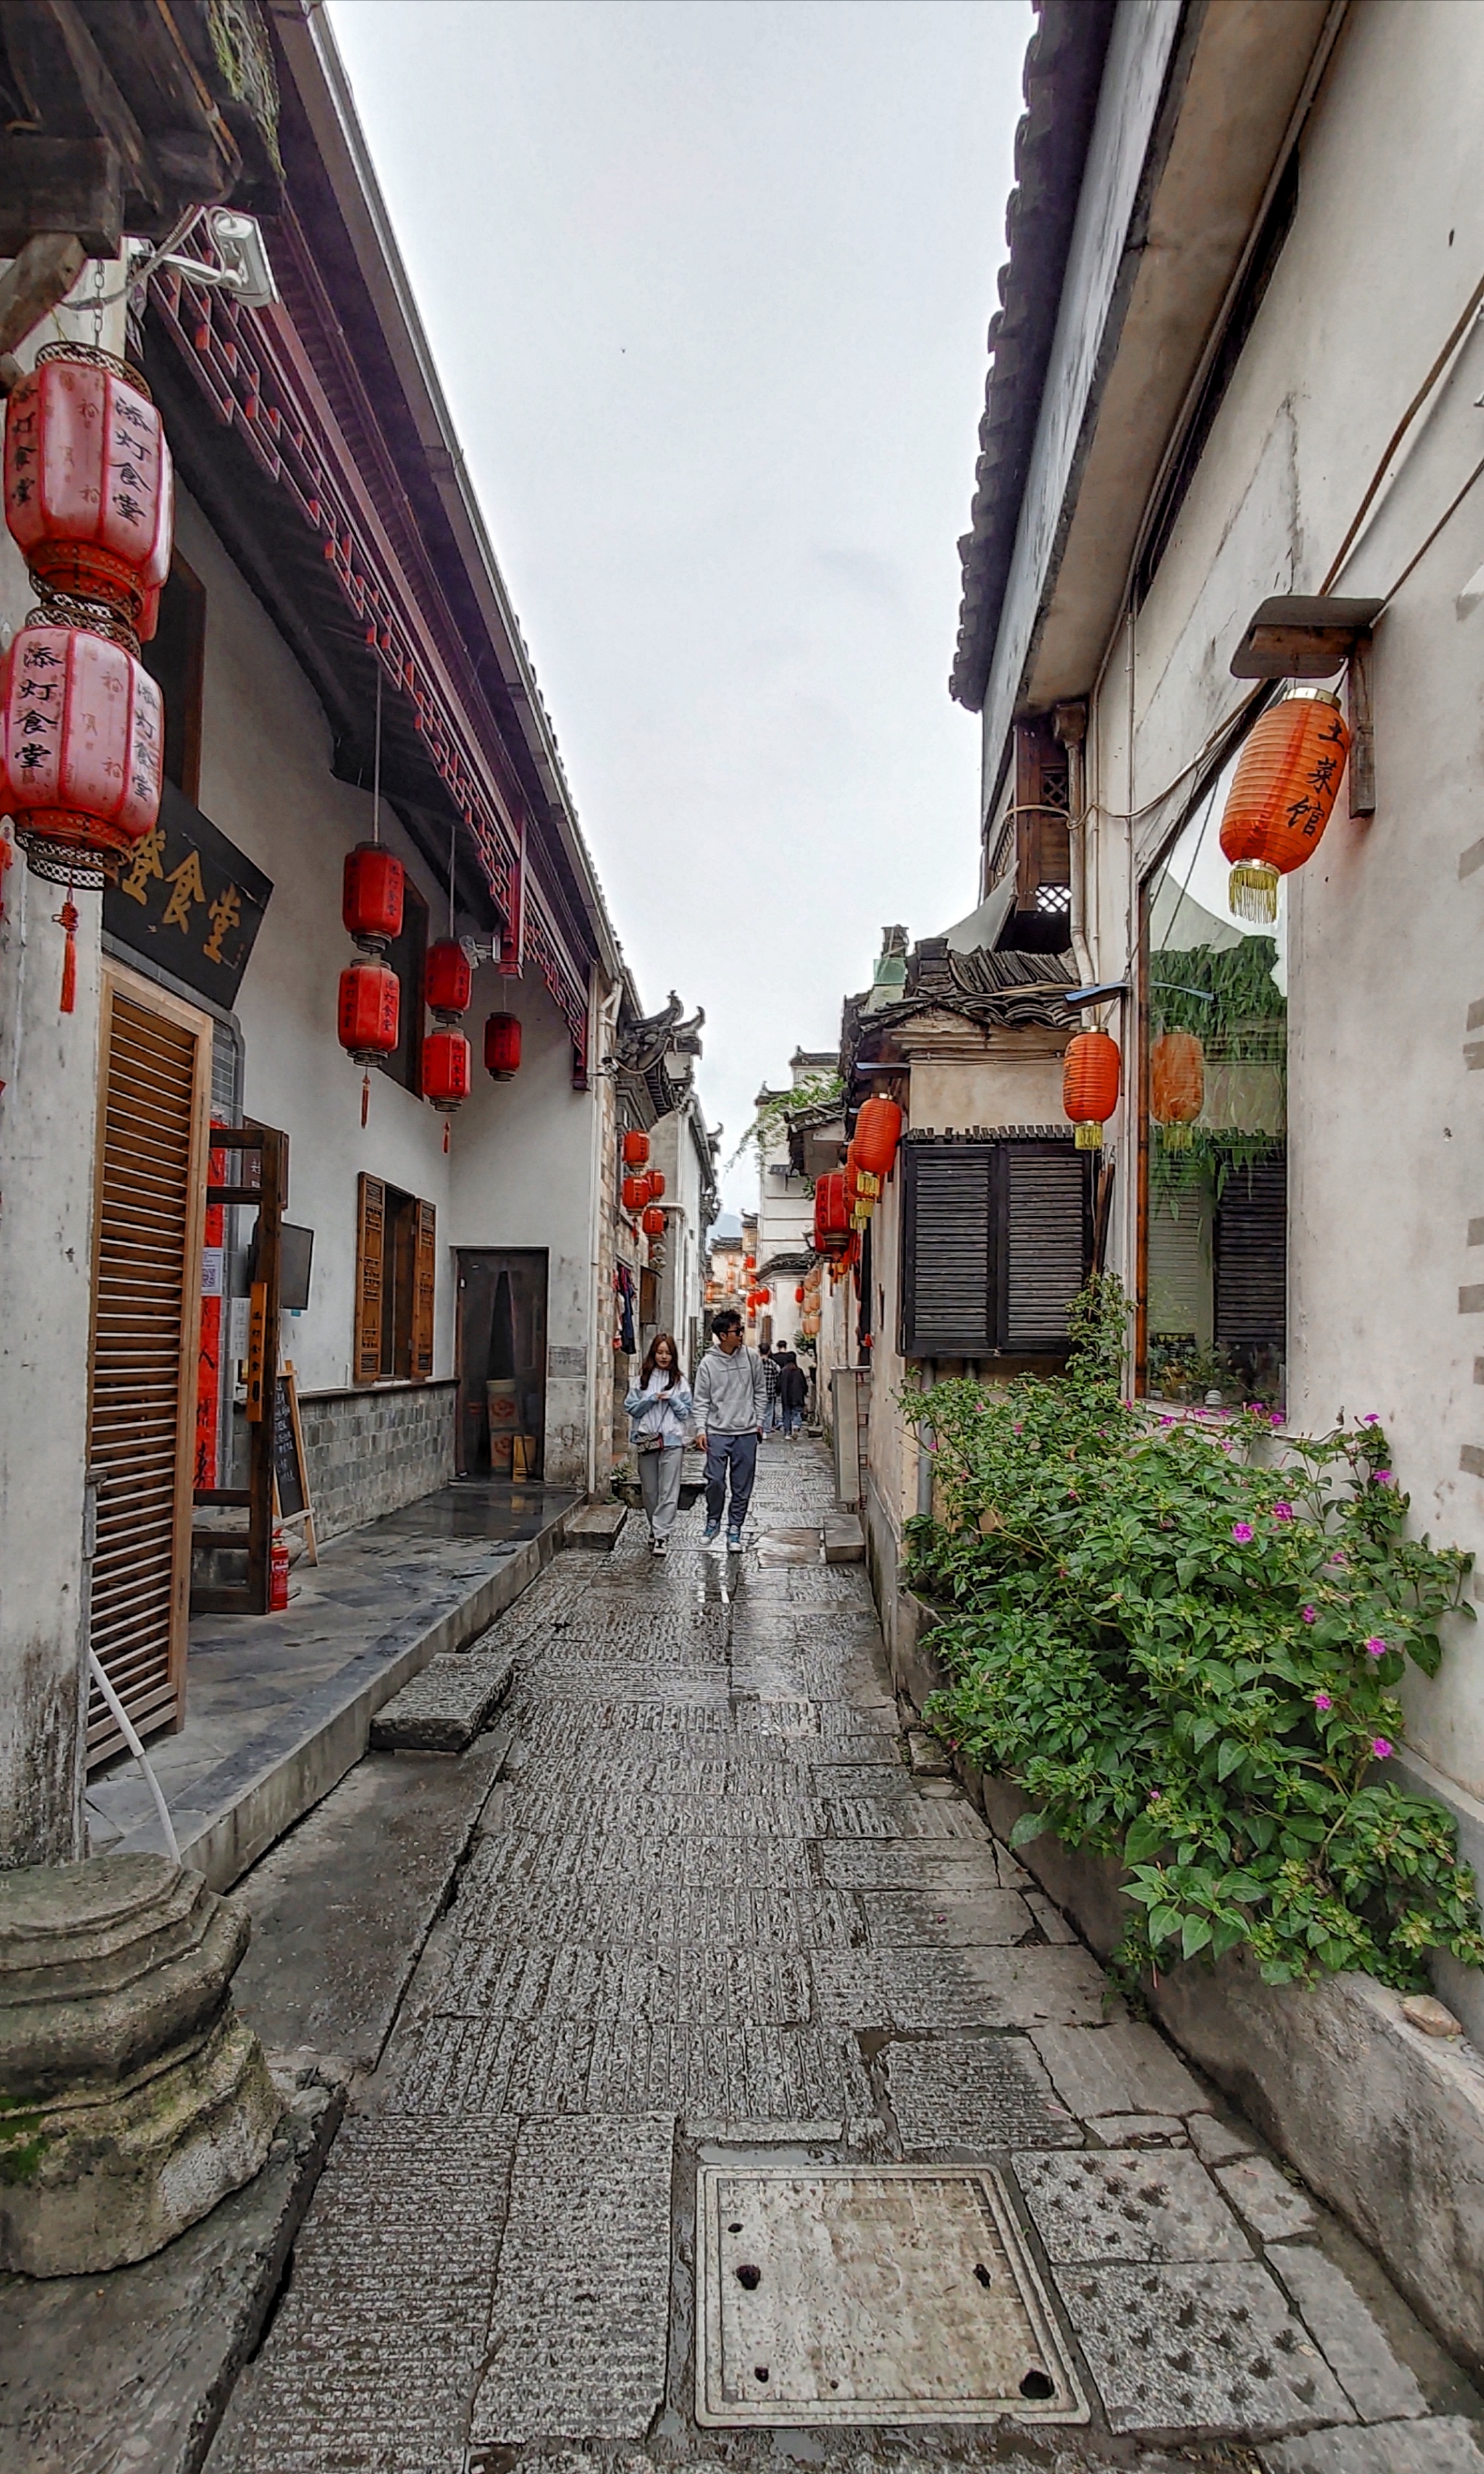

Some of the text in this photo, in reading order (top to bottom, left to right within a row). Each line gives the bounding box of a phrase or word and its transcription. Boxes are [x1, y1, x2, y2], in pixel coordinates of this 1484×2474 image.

[107, 396, 155, 527] 添灯食堂
[13, 646, 64, 769] 添灯食堂
[1286, 718, 1345, 836] 土菜馆
